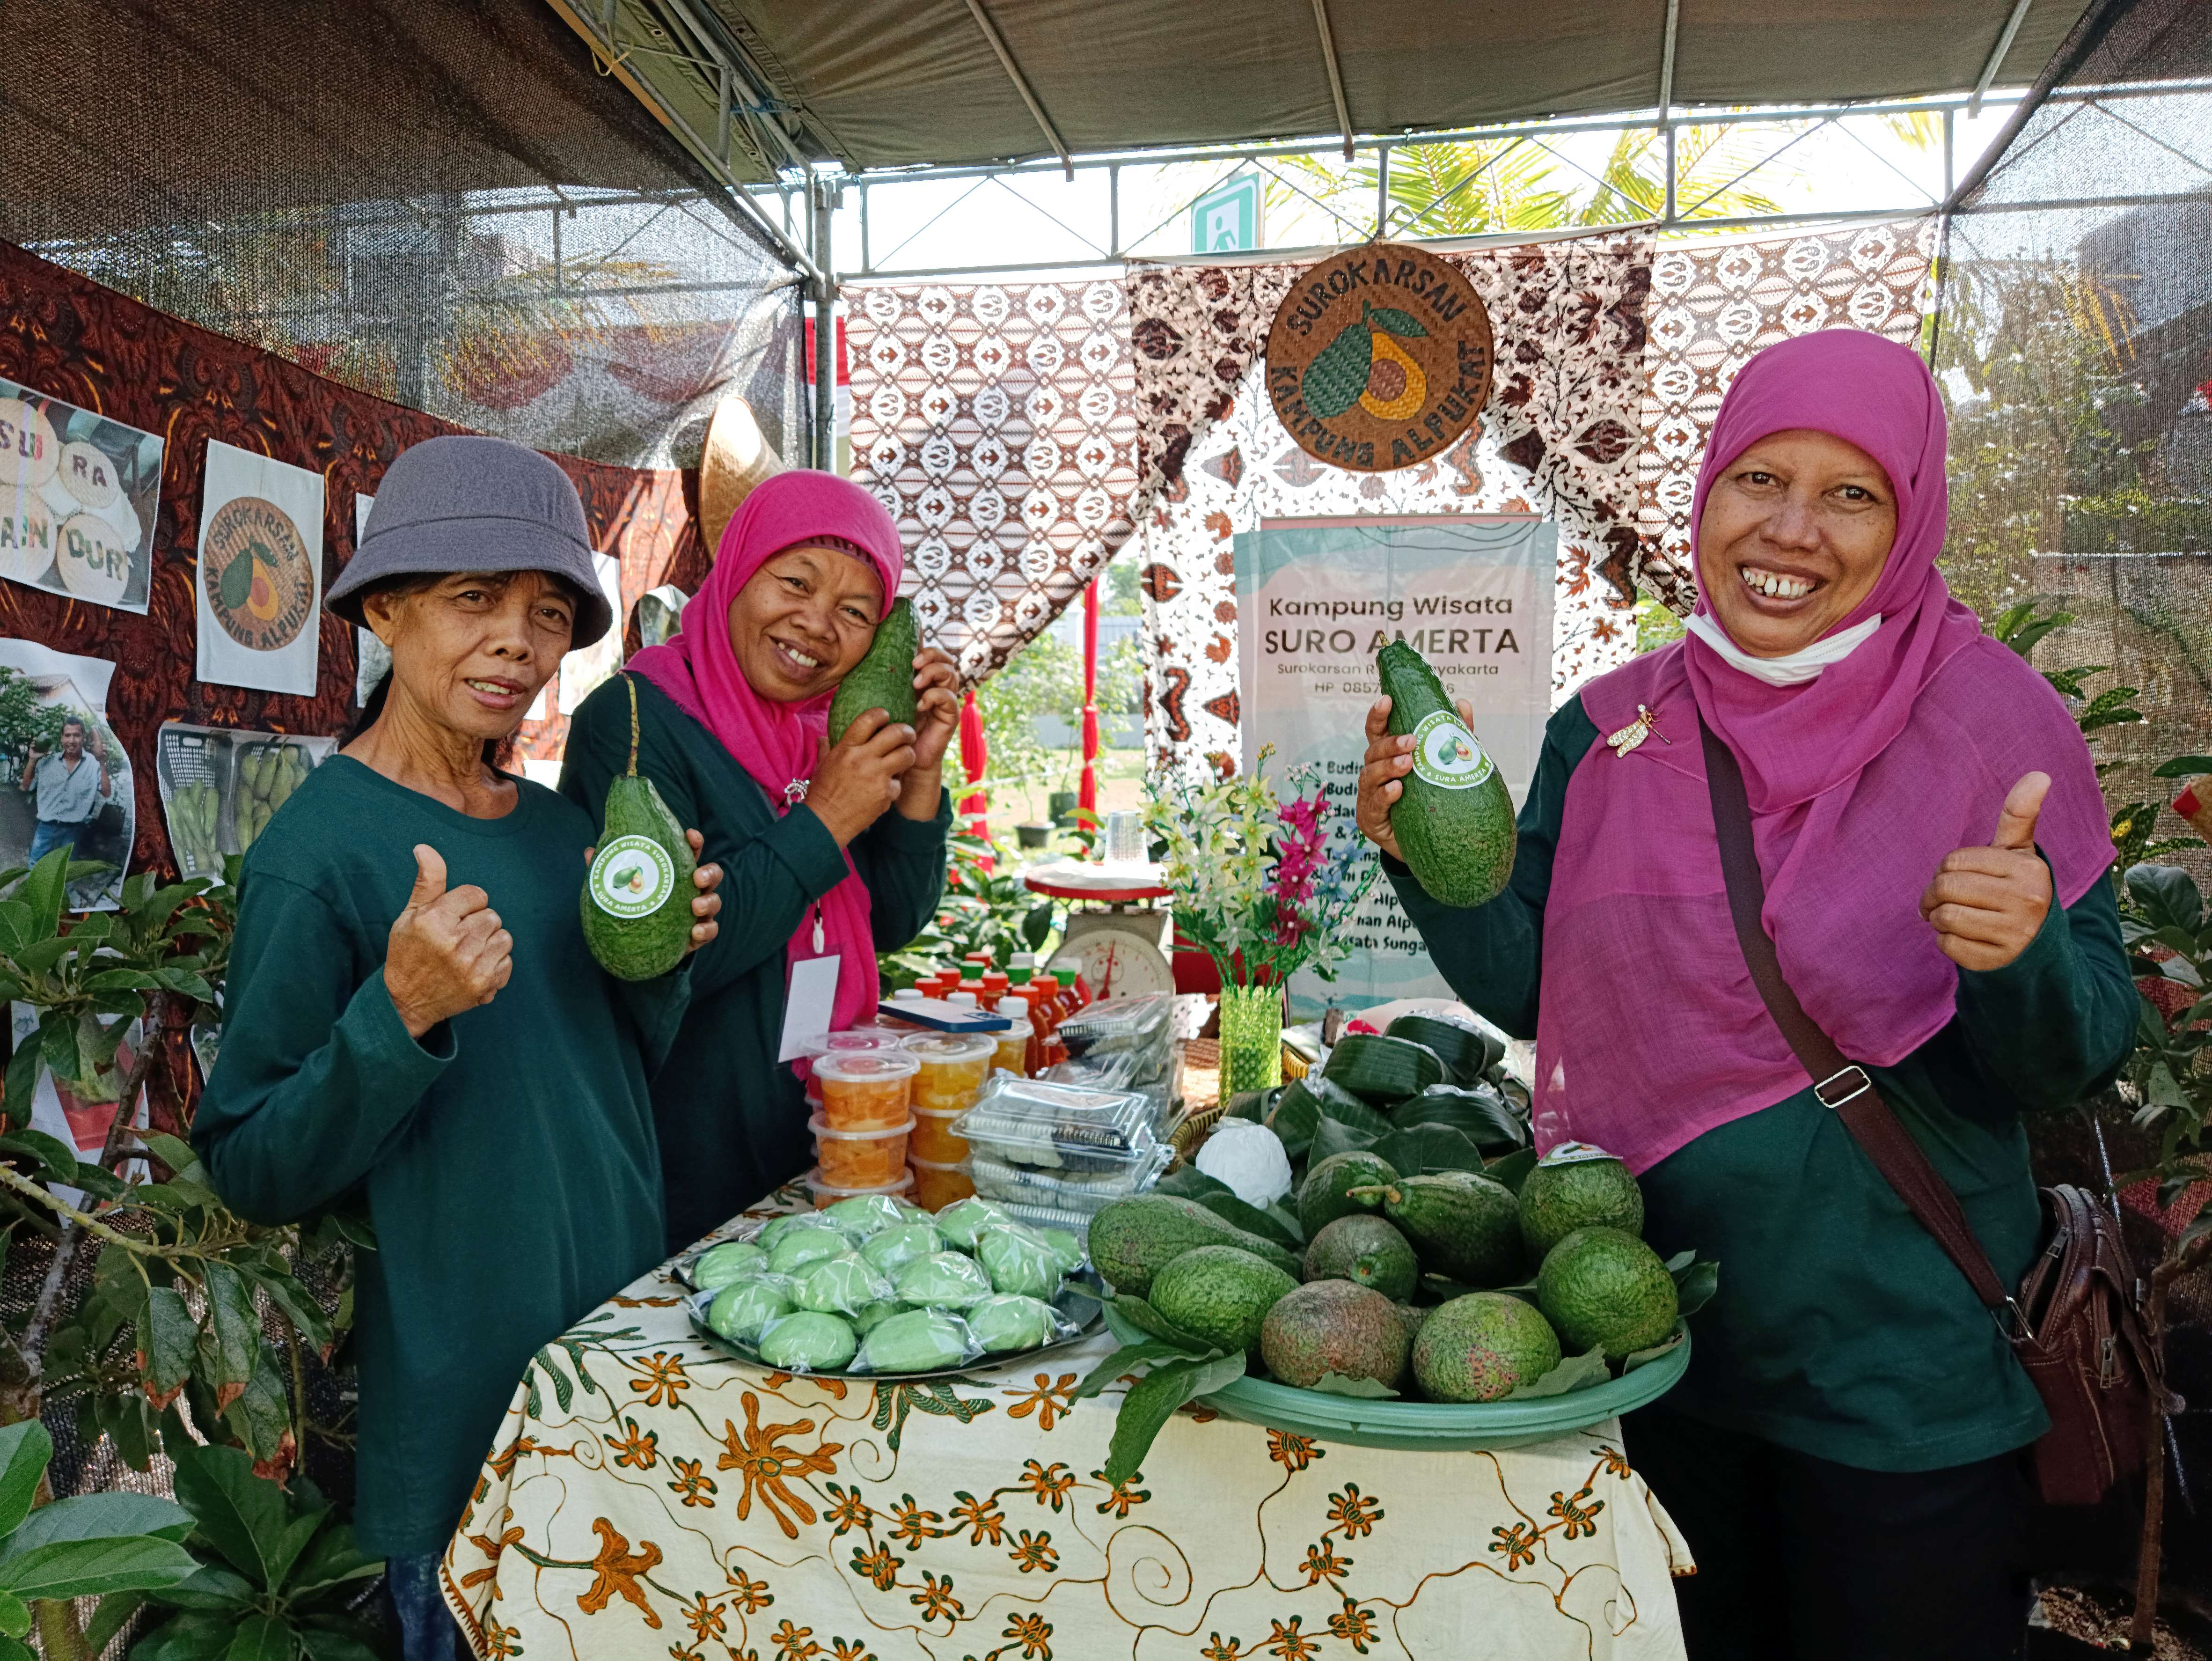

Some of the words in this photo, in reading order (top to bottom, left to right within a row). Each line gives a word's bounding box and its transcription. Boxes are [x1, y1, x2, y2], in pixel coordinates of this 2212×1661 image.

[1287, 258, 1468, 336] SUROKARSAN
[1270, 366, 1374, 467] KAMPUNG
[1391, 339, 1486, 466] ALPUKAT
[206, 566, 253, 646] KAMPUNG
[261, 576, 308, 647] ALPUKAT
[1270, 598, 1404, 622] Kampung
[1412, 595, 1513, 615] Wisata
[1265, 629, 1356, 654] SURO
[1277, 663, 1361, 674] Surokarsan
[1433, 663, 1498, 677] yakarta
[1315, 682, 1334, 692] HP
[1343, 682, 1380, 694] 0857
[1422, 715, 1451, 732] WISATA
[1435, 774, 1457, 782] SURA
[1459, 767, 1487, 782] AMERTA
[594, 845, 619, 880] KAMPUNG
[621, 841, 651, 851] WISATA
[652, 849, 670, 900] SUROKARSAN
[597, 891, 613, 907] SURA
[614, 904, 647, 912] AMERTA
[1383, 935, 1427, 956] Sunga
